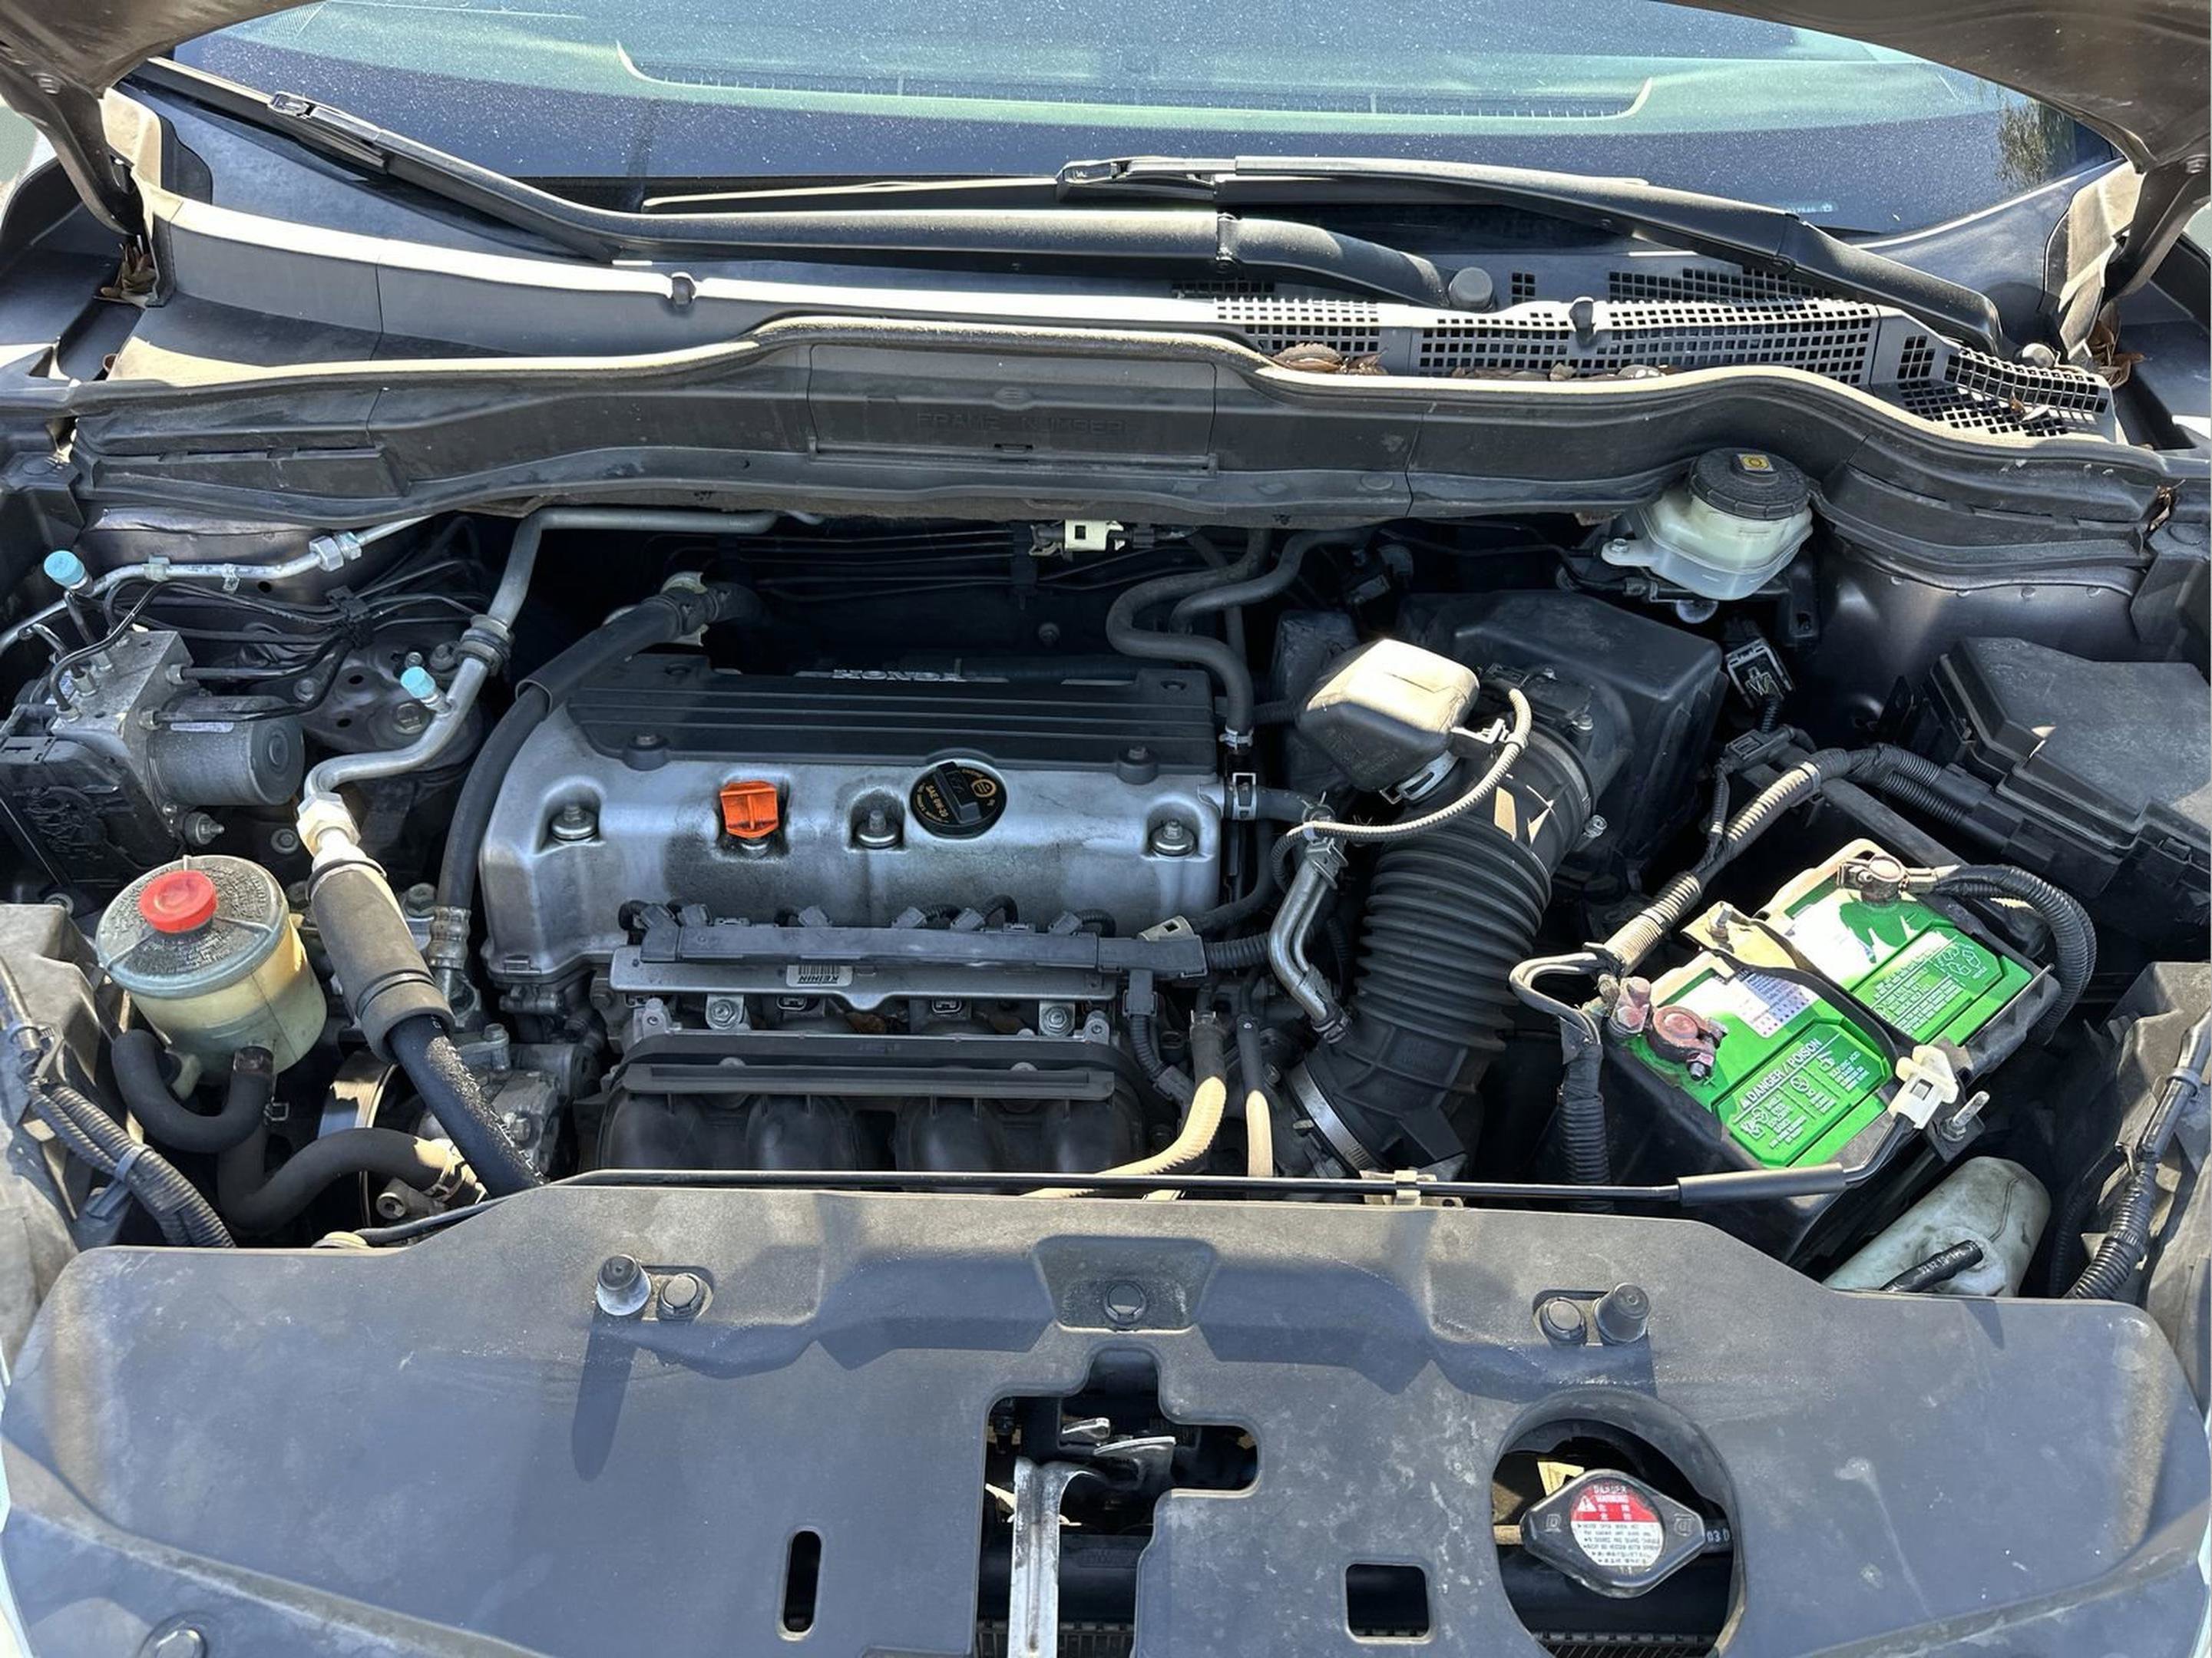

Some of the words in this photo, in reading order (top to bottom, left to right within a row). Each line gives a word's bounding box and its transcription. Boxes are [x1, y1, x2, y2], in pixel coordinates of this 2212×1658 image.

[917, 412, 1001, 431] FRAME
[1022, 416, 1129, 435] NUMBER
[832, 669, 967, 682] HONDA
[1747, 1068, 1784, 1103] DANGER
[1788, 1038, 1823, 1068] POISON
